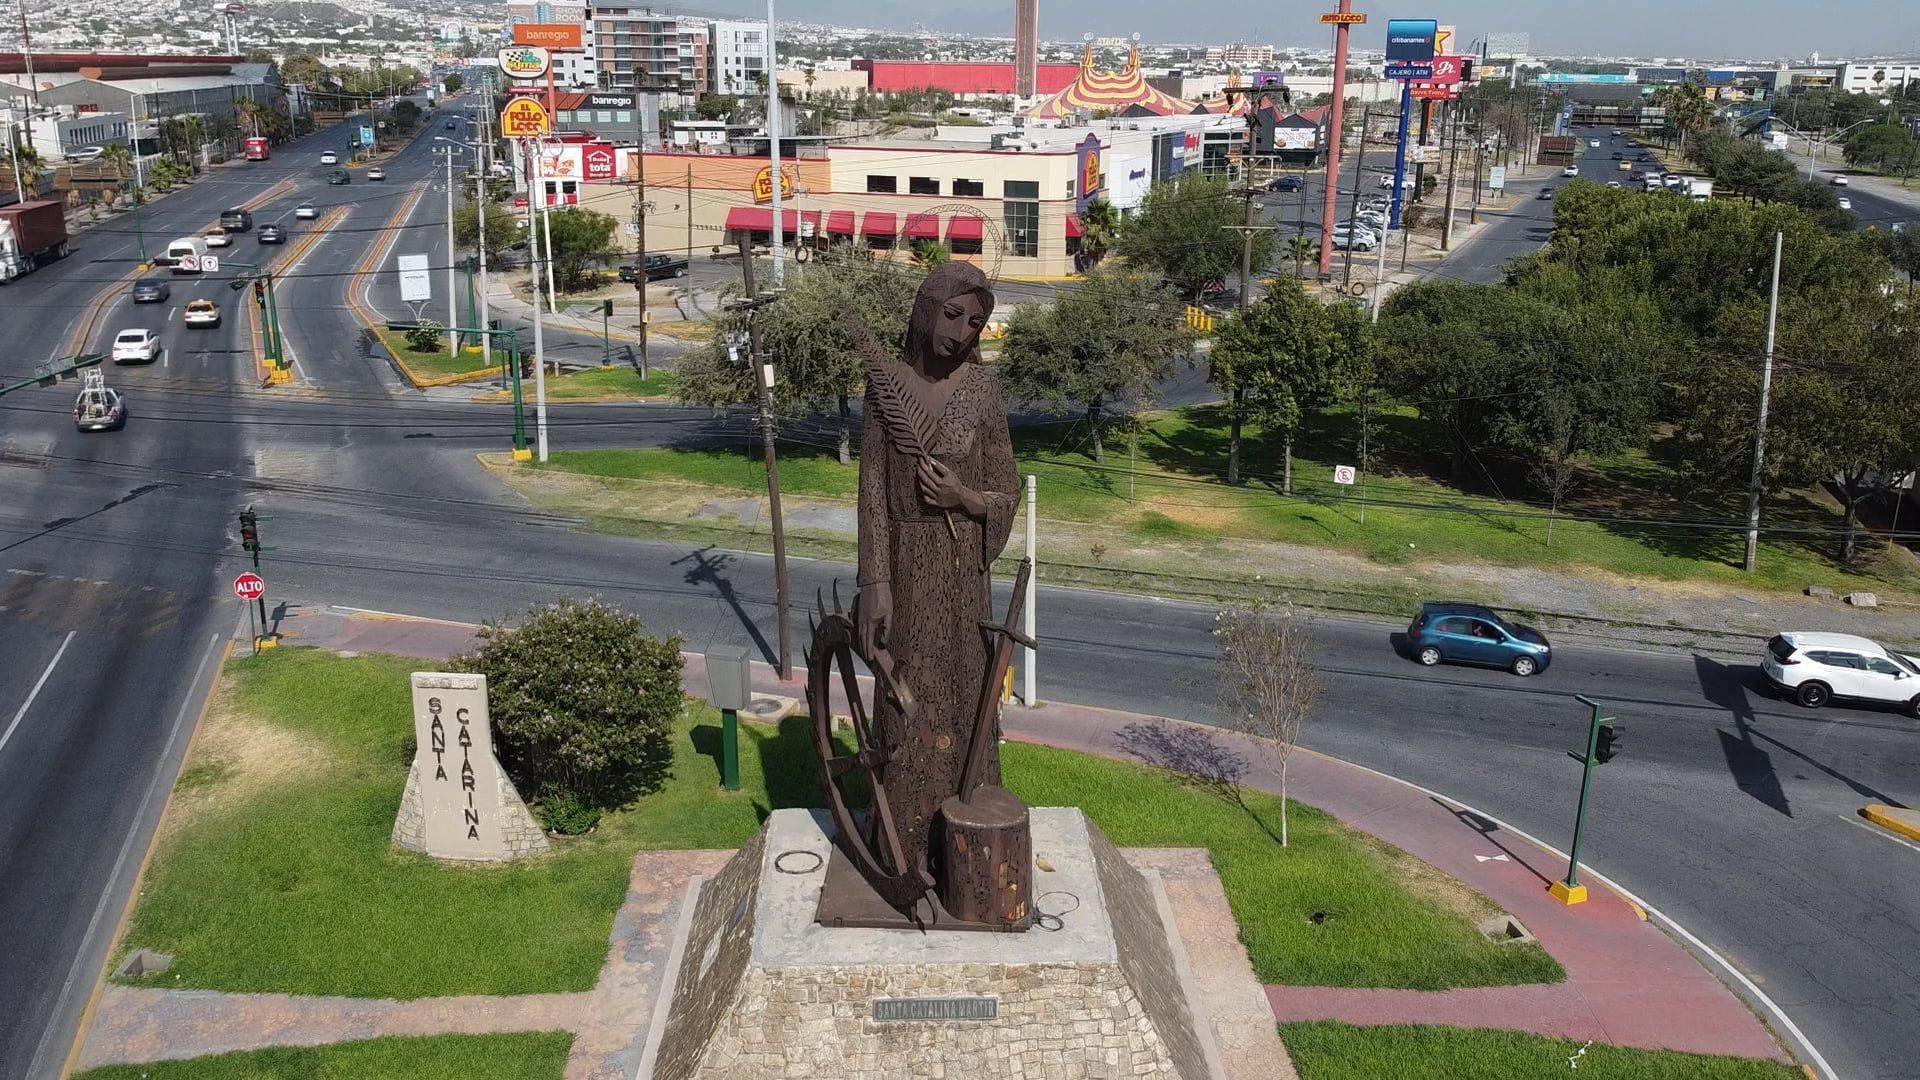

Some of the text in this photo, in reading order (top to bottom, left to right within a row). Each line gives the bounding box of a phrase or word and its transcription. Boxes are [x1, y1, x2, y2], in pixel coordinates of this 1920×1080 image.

[526, 30, 570, 41] banregio
[1436, 61, 1456, 75] Jr.
[592, 96, 632, 106] banregio
[510, 112, 542, 121] POLLO
[511, 122, 542, 132] LOCO
[590, 163, 611, 172] tota
[237, 581, 263, 592] ALTO
[428, 697, 448, 781] SANTA
[456, 708, 480, 841] CATARINA
[878, 1002, 909, 1018] SANTA
